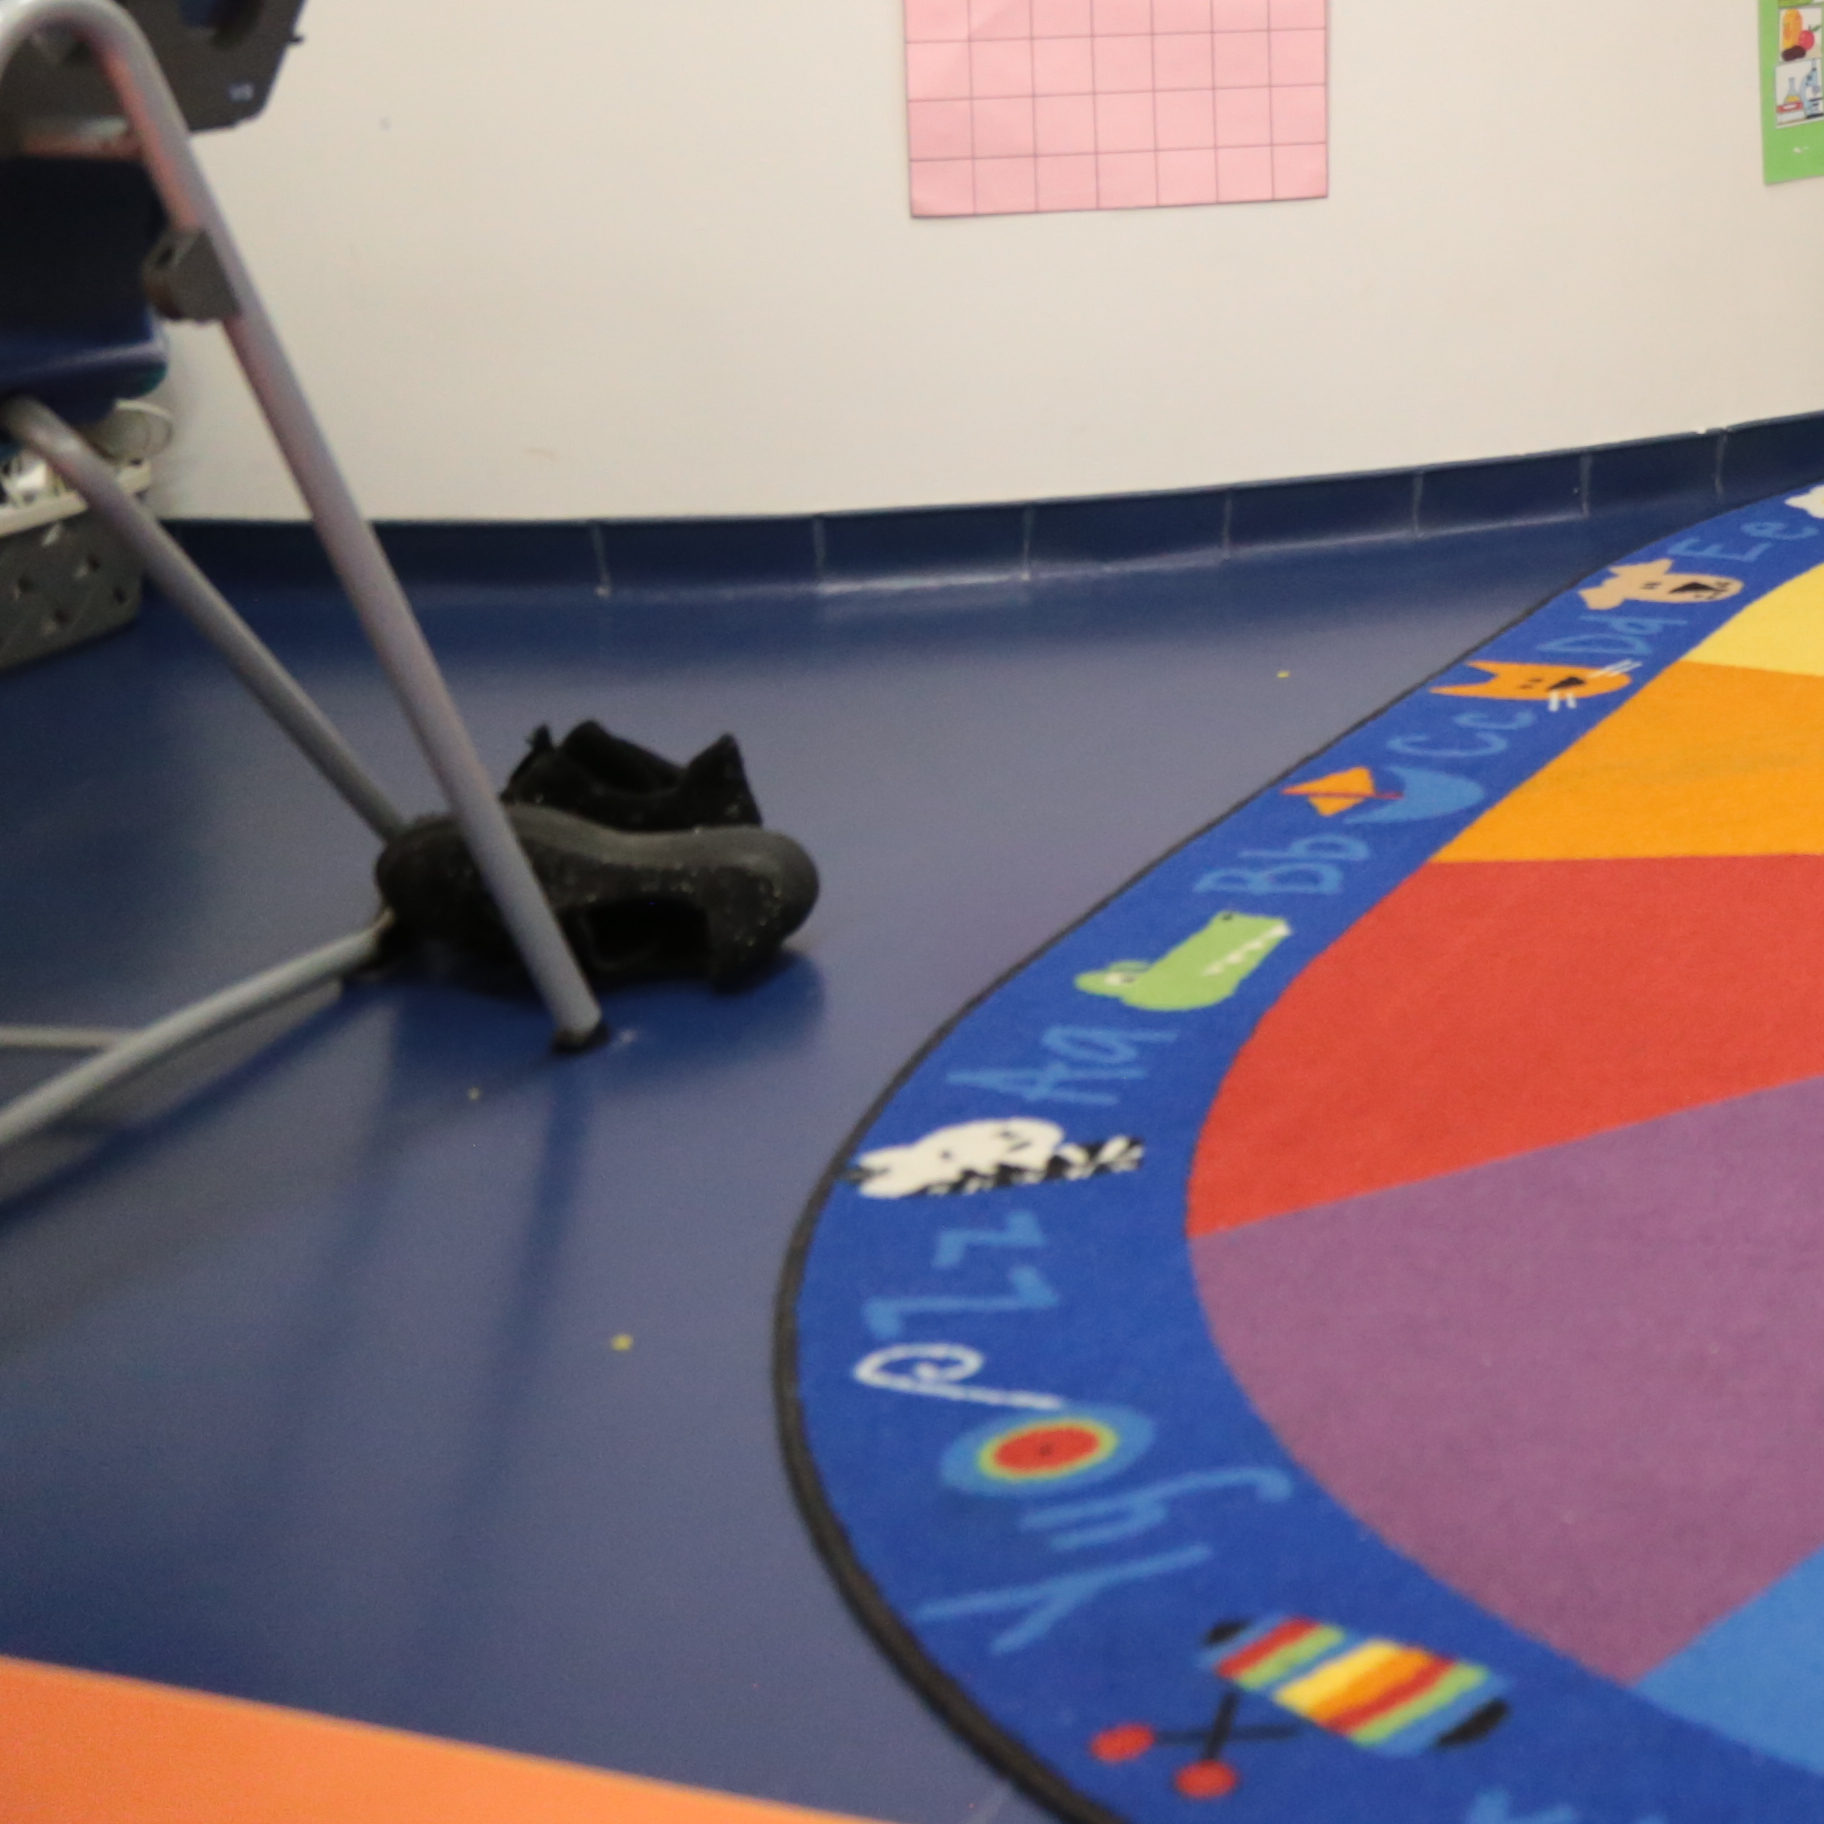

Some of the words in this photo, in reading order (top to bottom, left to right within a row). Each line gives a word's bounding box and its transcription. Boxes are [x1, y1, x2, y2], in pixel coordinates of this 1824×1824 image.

[1668, 518, 1818, 563] Ee
[1534, 614, 1690, 660] Dd
[1392, 707, 1537, 760] Cc
[1193, 833, 1371, 894] Bb
[945, 1025, 1180, 1106] Aa
[862, 1209, 1060, 1339] Zz
[914, 1464, 1293, 1655] Yy
